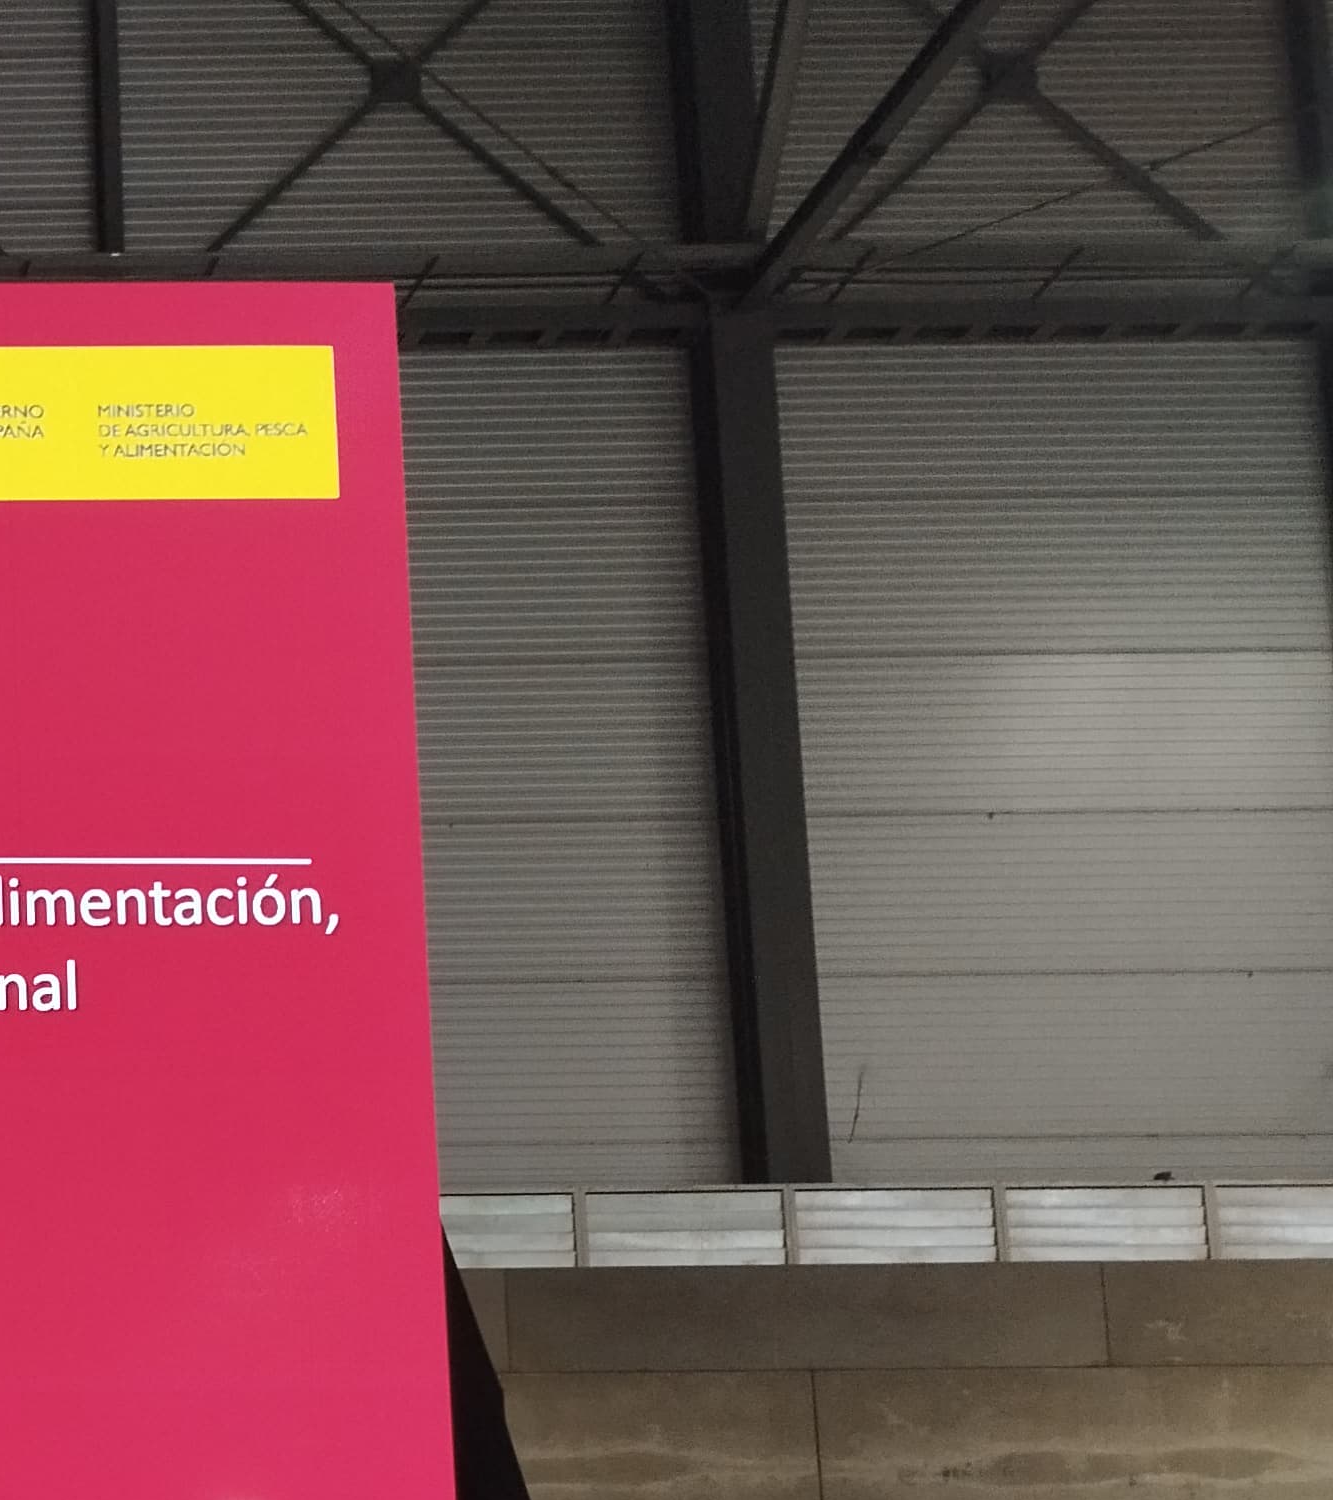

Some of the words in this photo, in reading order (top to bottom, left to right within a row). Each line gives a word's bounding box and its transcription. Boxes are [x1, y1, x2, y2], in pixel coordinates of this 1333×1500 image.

[97, 403, 195, 418] MINISTERIO
[98, 424, 121, 437] DE
[255, 423, 308, 436] PESCA
[99, 444, 110, 456] Y
[113, 441, 246, 457] ALIMENTACIÓN
